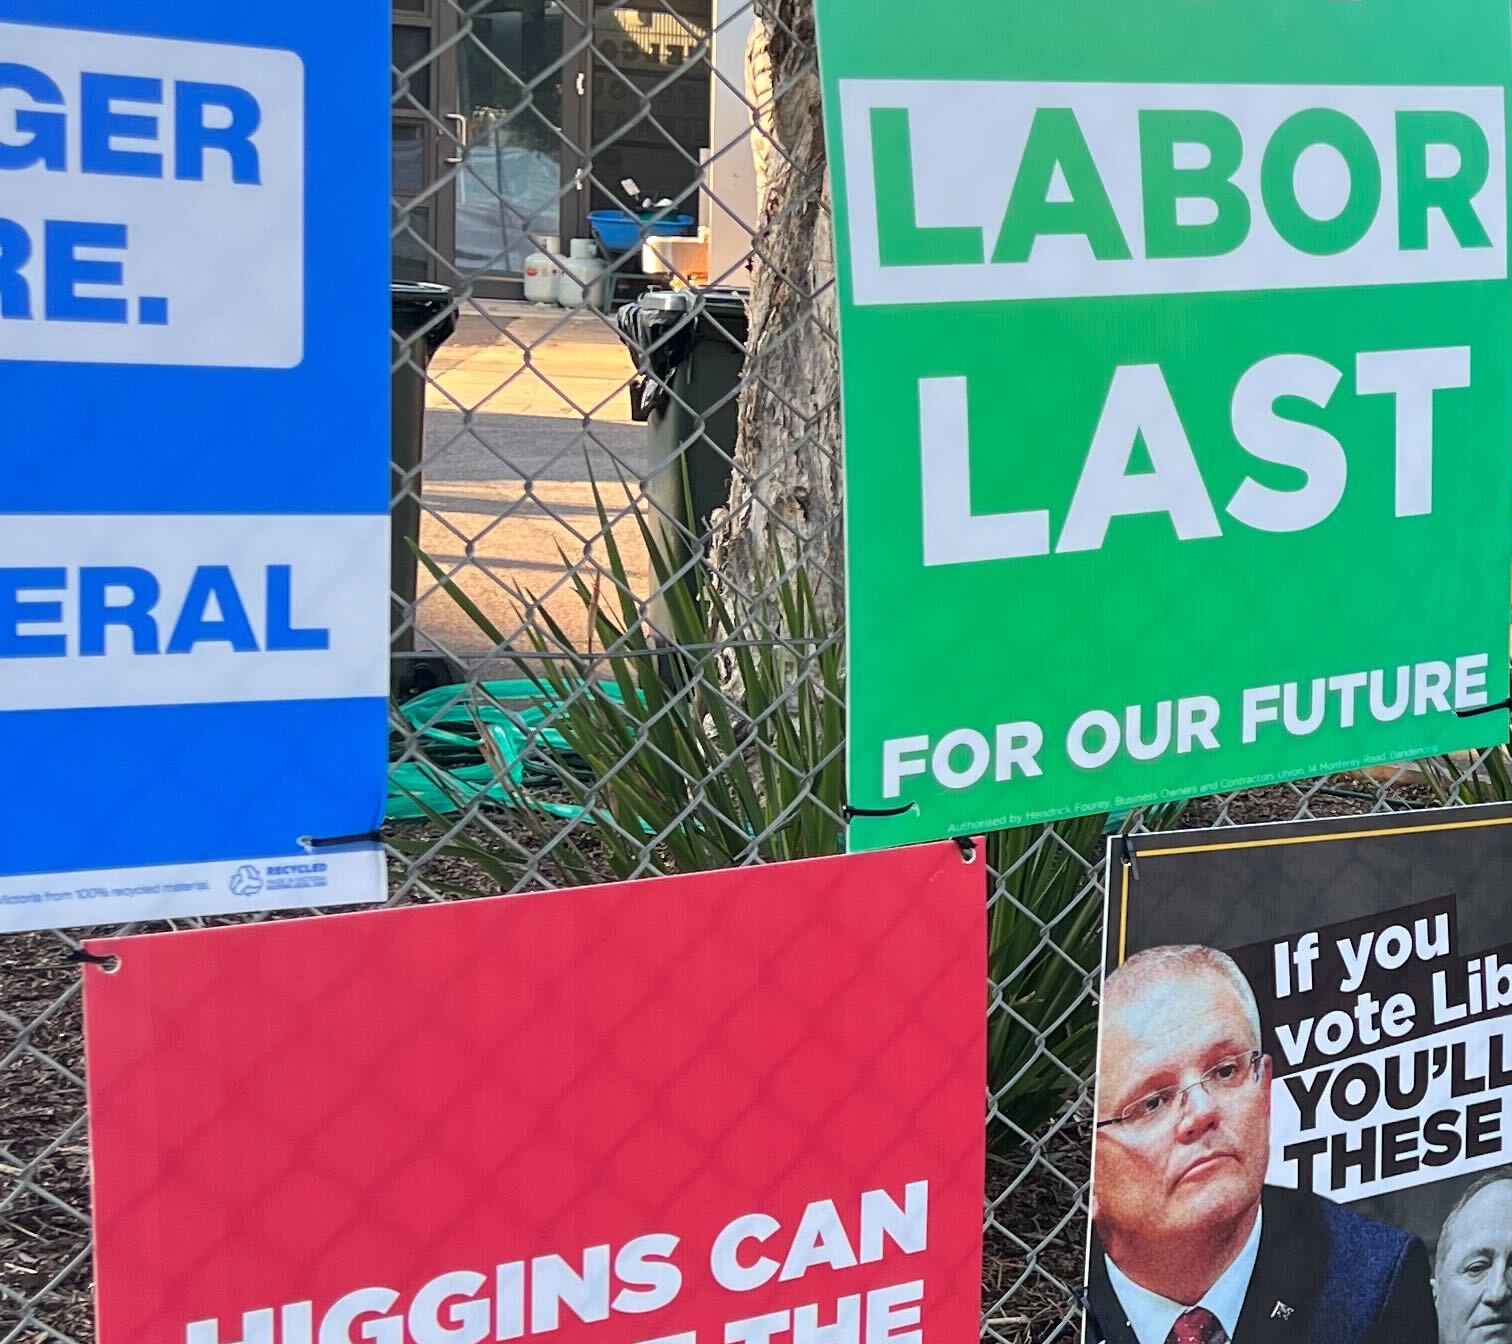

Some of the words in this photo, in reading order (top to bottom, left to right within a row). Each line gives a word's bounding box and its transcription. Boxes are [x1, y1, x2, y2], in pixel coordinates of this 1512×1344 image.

[0, 62, 262, 186] GER
[868, 106, 1494, 268] LABOR
[917, 344, 1472, 567] LAST
[0, 564, 330, 657] ERAL
[882, 720, 1044, 800] FOR
[1065, 694, 1221, 770] OUR
[1241, 652, 1489, 744] FUTURE
[948, 815, 1007, 834] Authorised
[1008, 812, 1022, 826] by
[1025, 807, 1072, 821] Hendrick
[1115, 791, 1158, 806] Business
[1160, 784, 1198, 799] Owners
[1200, 780, 1218, 792] and
[1221, 773, 1275, 789] Contractors
[1319, 758, 1361, 772] Monterey
[266, 862, 328, 875] RECYCLED
[1274, 931, 1321, 1000] If
[1335, 911, 1450, 994] you
[1274, 992, 1414, 1067] vote
[1282, 1100, 1502, 1192] THESE
[710, 1179, 930, 1292] CAN
